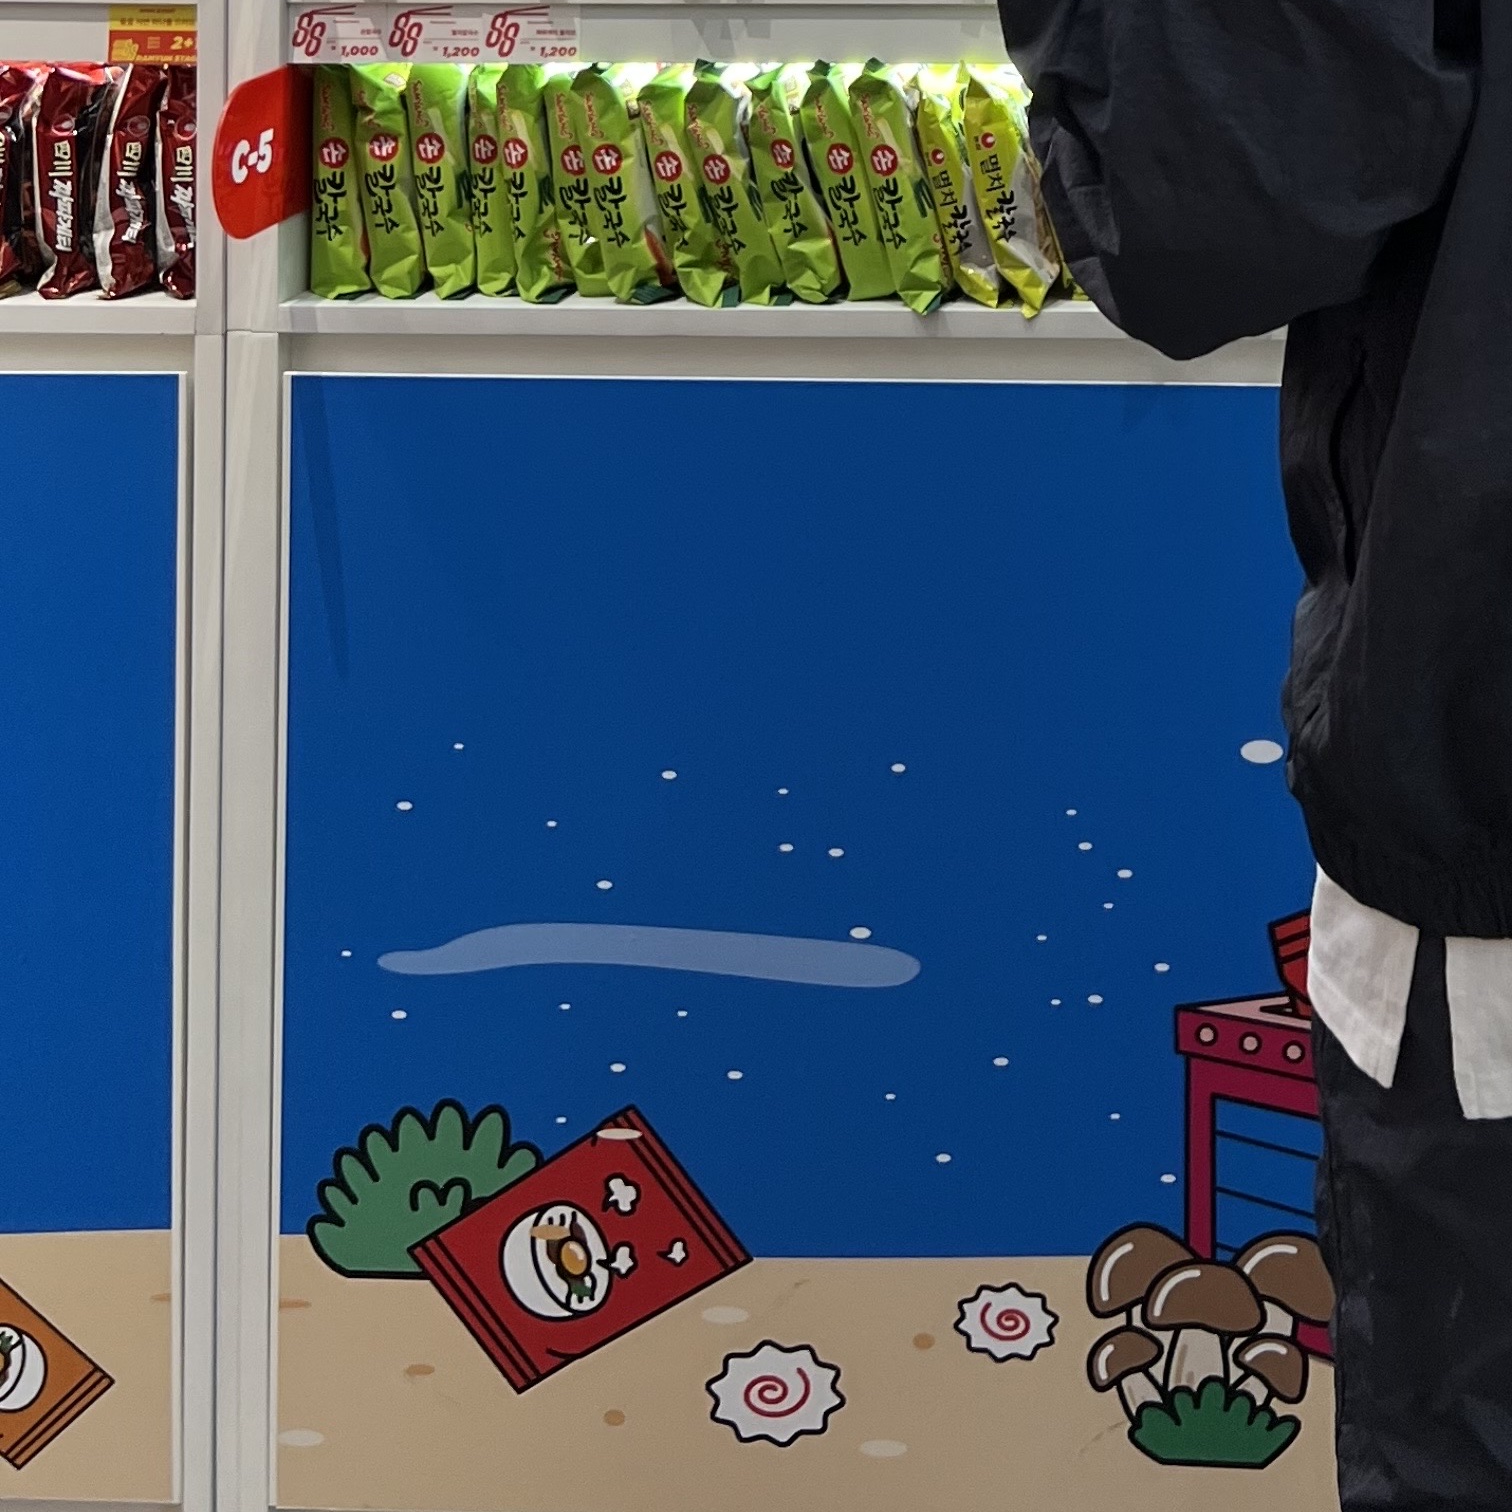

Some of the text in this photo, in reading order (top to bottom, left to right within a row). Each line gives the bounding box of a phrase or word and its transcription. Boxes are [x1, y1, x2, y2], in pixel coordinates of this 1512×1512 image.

[341, 45, 378, 57] 1,000
[443, 45, 479, 57] 1,200
[540, 45, 577, 57] 1,200
[232, 128, 274, 184] C-5
